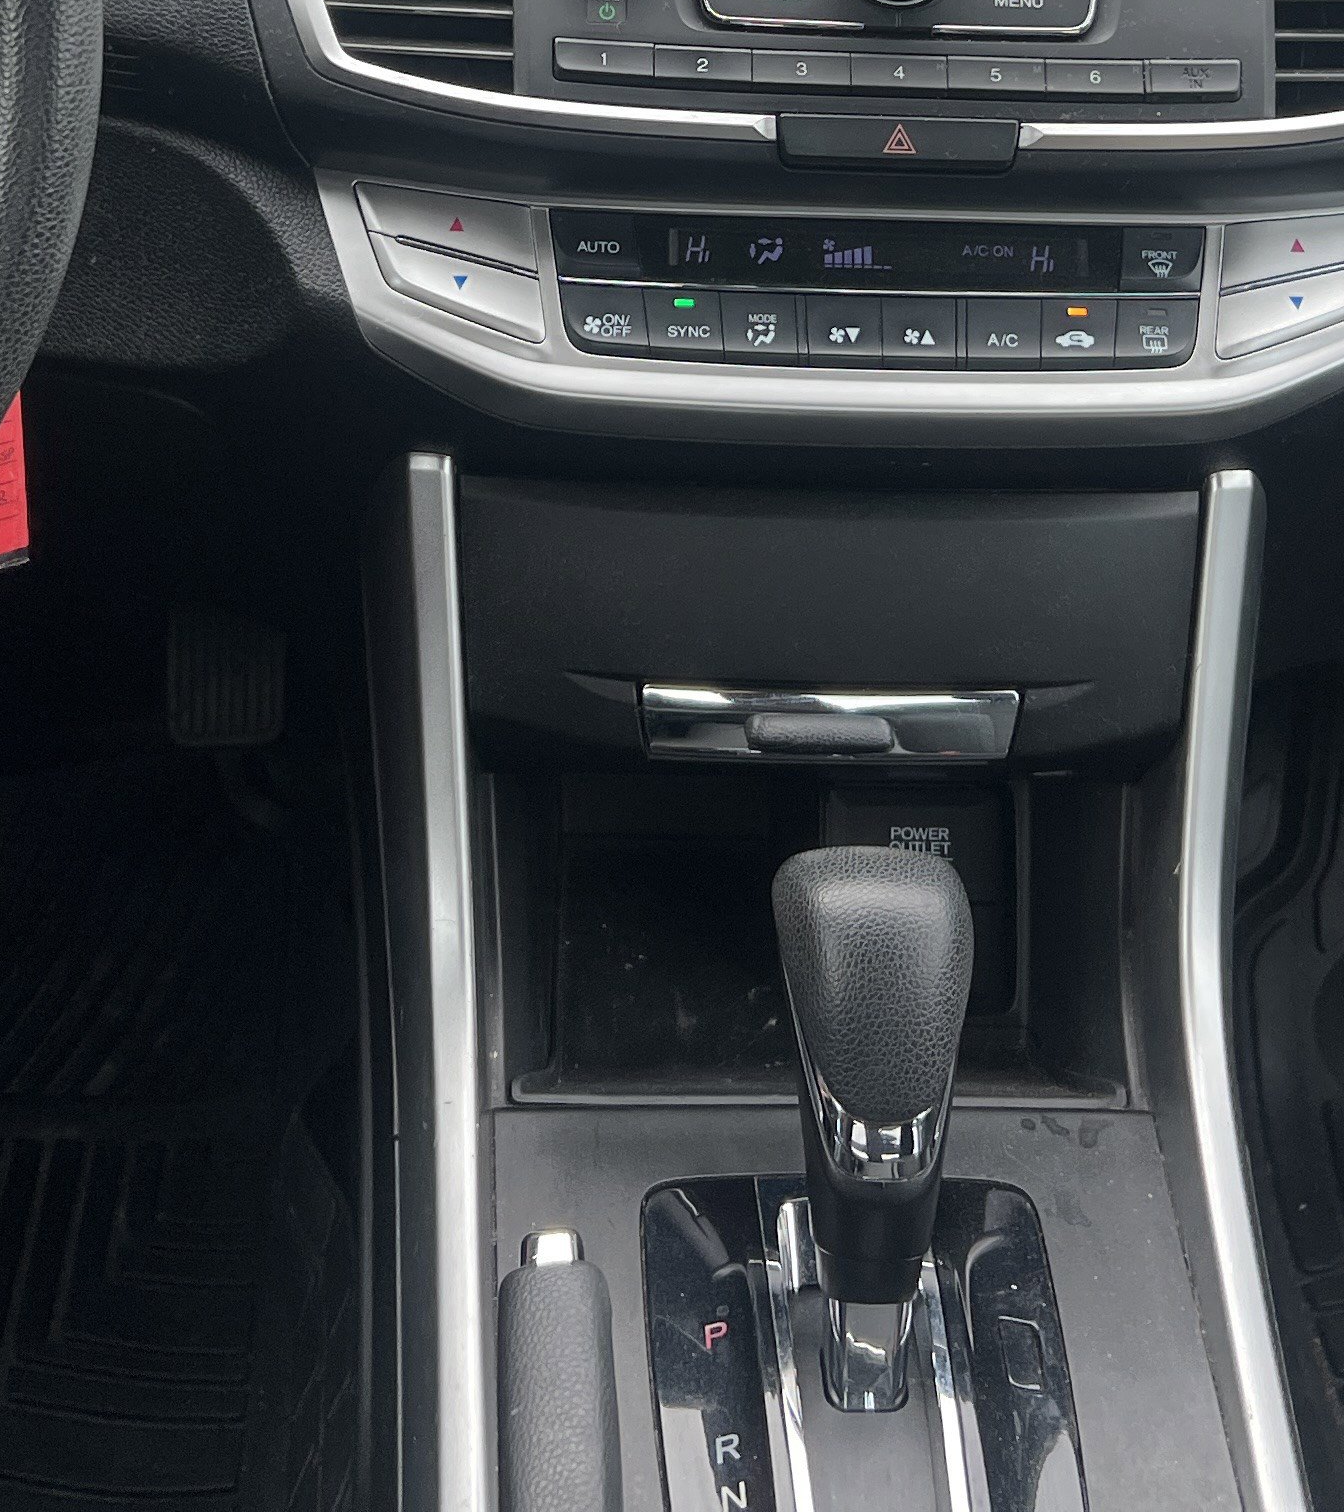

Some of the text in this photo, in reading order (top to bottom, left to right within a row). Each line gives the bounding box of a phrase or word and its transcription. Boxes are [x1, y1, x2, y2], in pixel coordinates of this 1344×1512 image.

[696, 58, 709, 72] 2
[796, 63, 808, 76] 3
[893, 66, 905, 80] 4
[990, 68, 1002, 82] 5
[1089, 70, 1101, 84] 6
[1183, 66, 1212, 79] AUX
[1189, 79, 1204, 89] IN
[577, 241, 620, 254] AUTO
[961, 245, 1013, 258] A/C ON
[1141, 250, 1178, 261] FRONT
[602, 314, 631, 327] ON/
[748, 314, 777, 324] MODE
[601, 325, 632, 338] OFF
[667, 325, 711, 338] SYNC
[1139, 326, 1169, 336] REAR
[987, 334, 1018, 348] A/C
[890, 827, 950, 841] POWER
[704, 1320, 728, 1350] P
[715, 1433, 741, 1465] R
[720, 1480, 748, 1512] N
